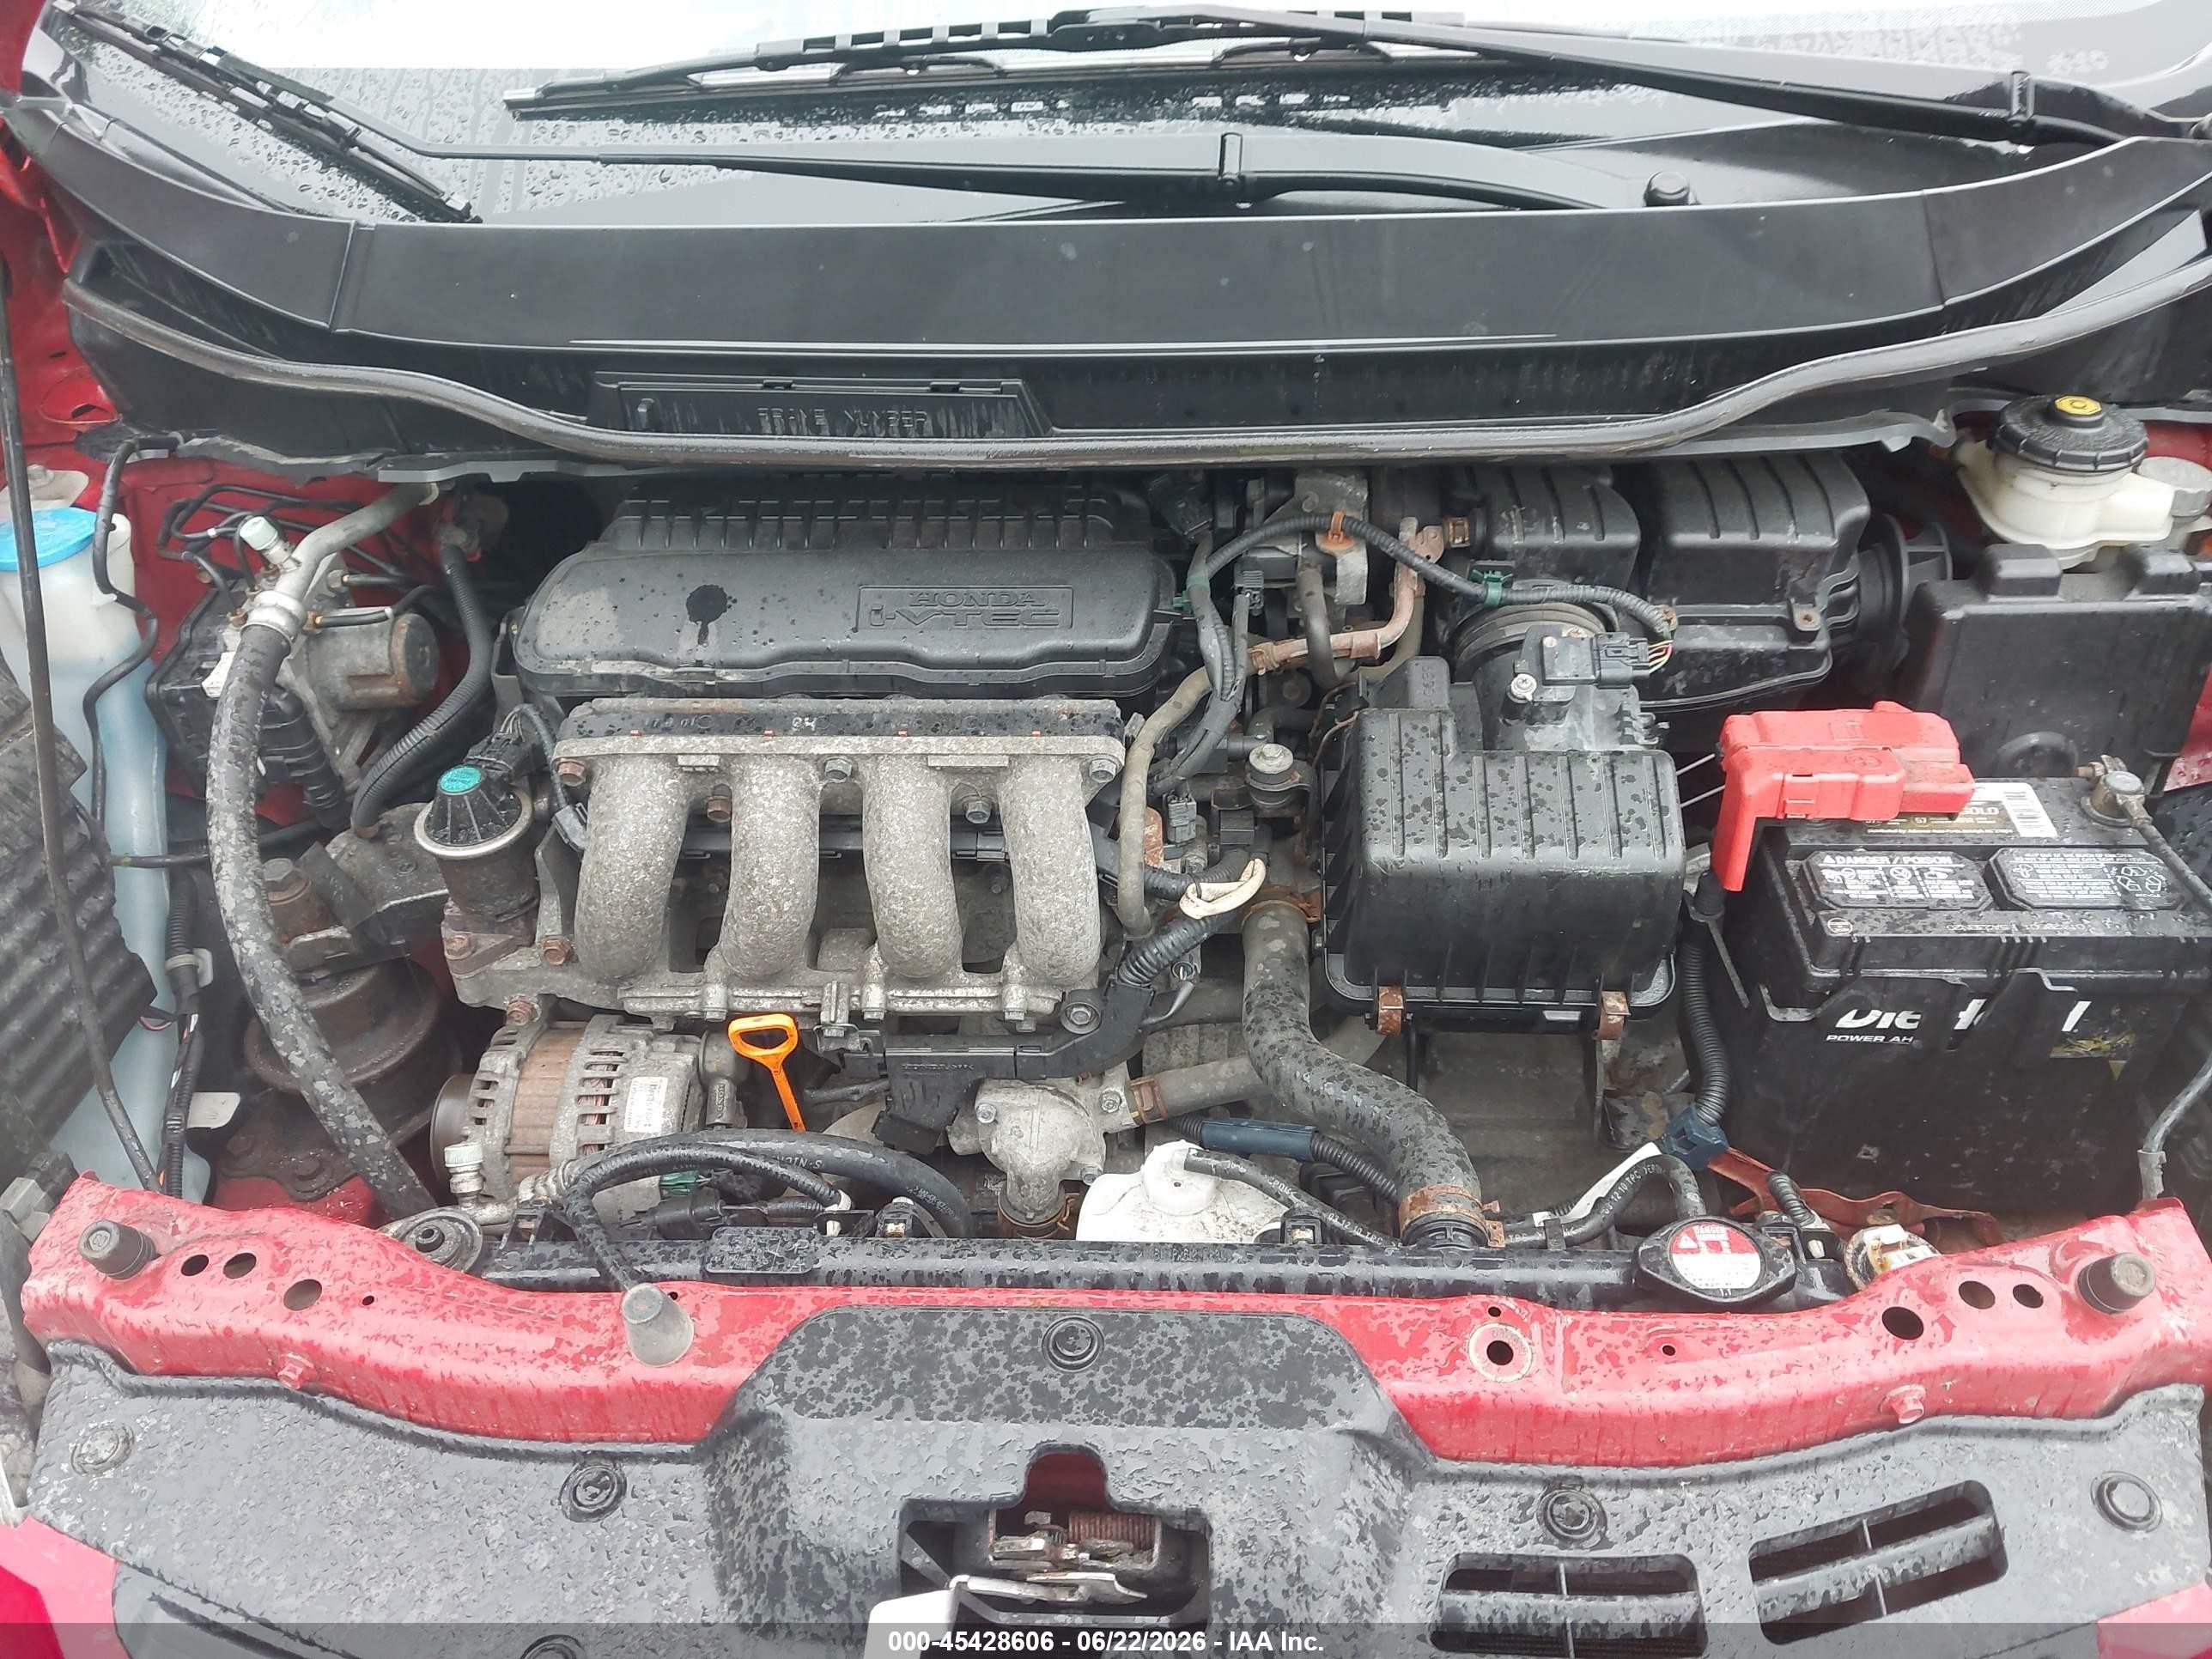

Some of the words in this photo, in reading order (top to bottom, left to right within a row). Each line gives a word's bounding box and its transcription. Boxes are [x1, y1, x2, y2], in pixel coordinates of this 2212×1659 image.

[908, 592, 1049, 607] HONDA
[1834, 855, 1892, 865] DANGER
[1902, 856, 1954, 865] POISON
[1826, 1034, 1886, 1043] POWER
